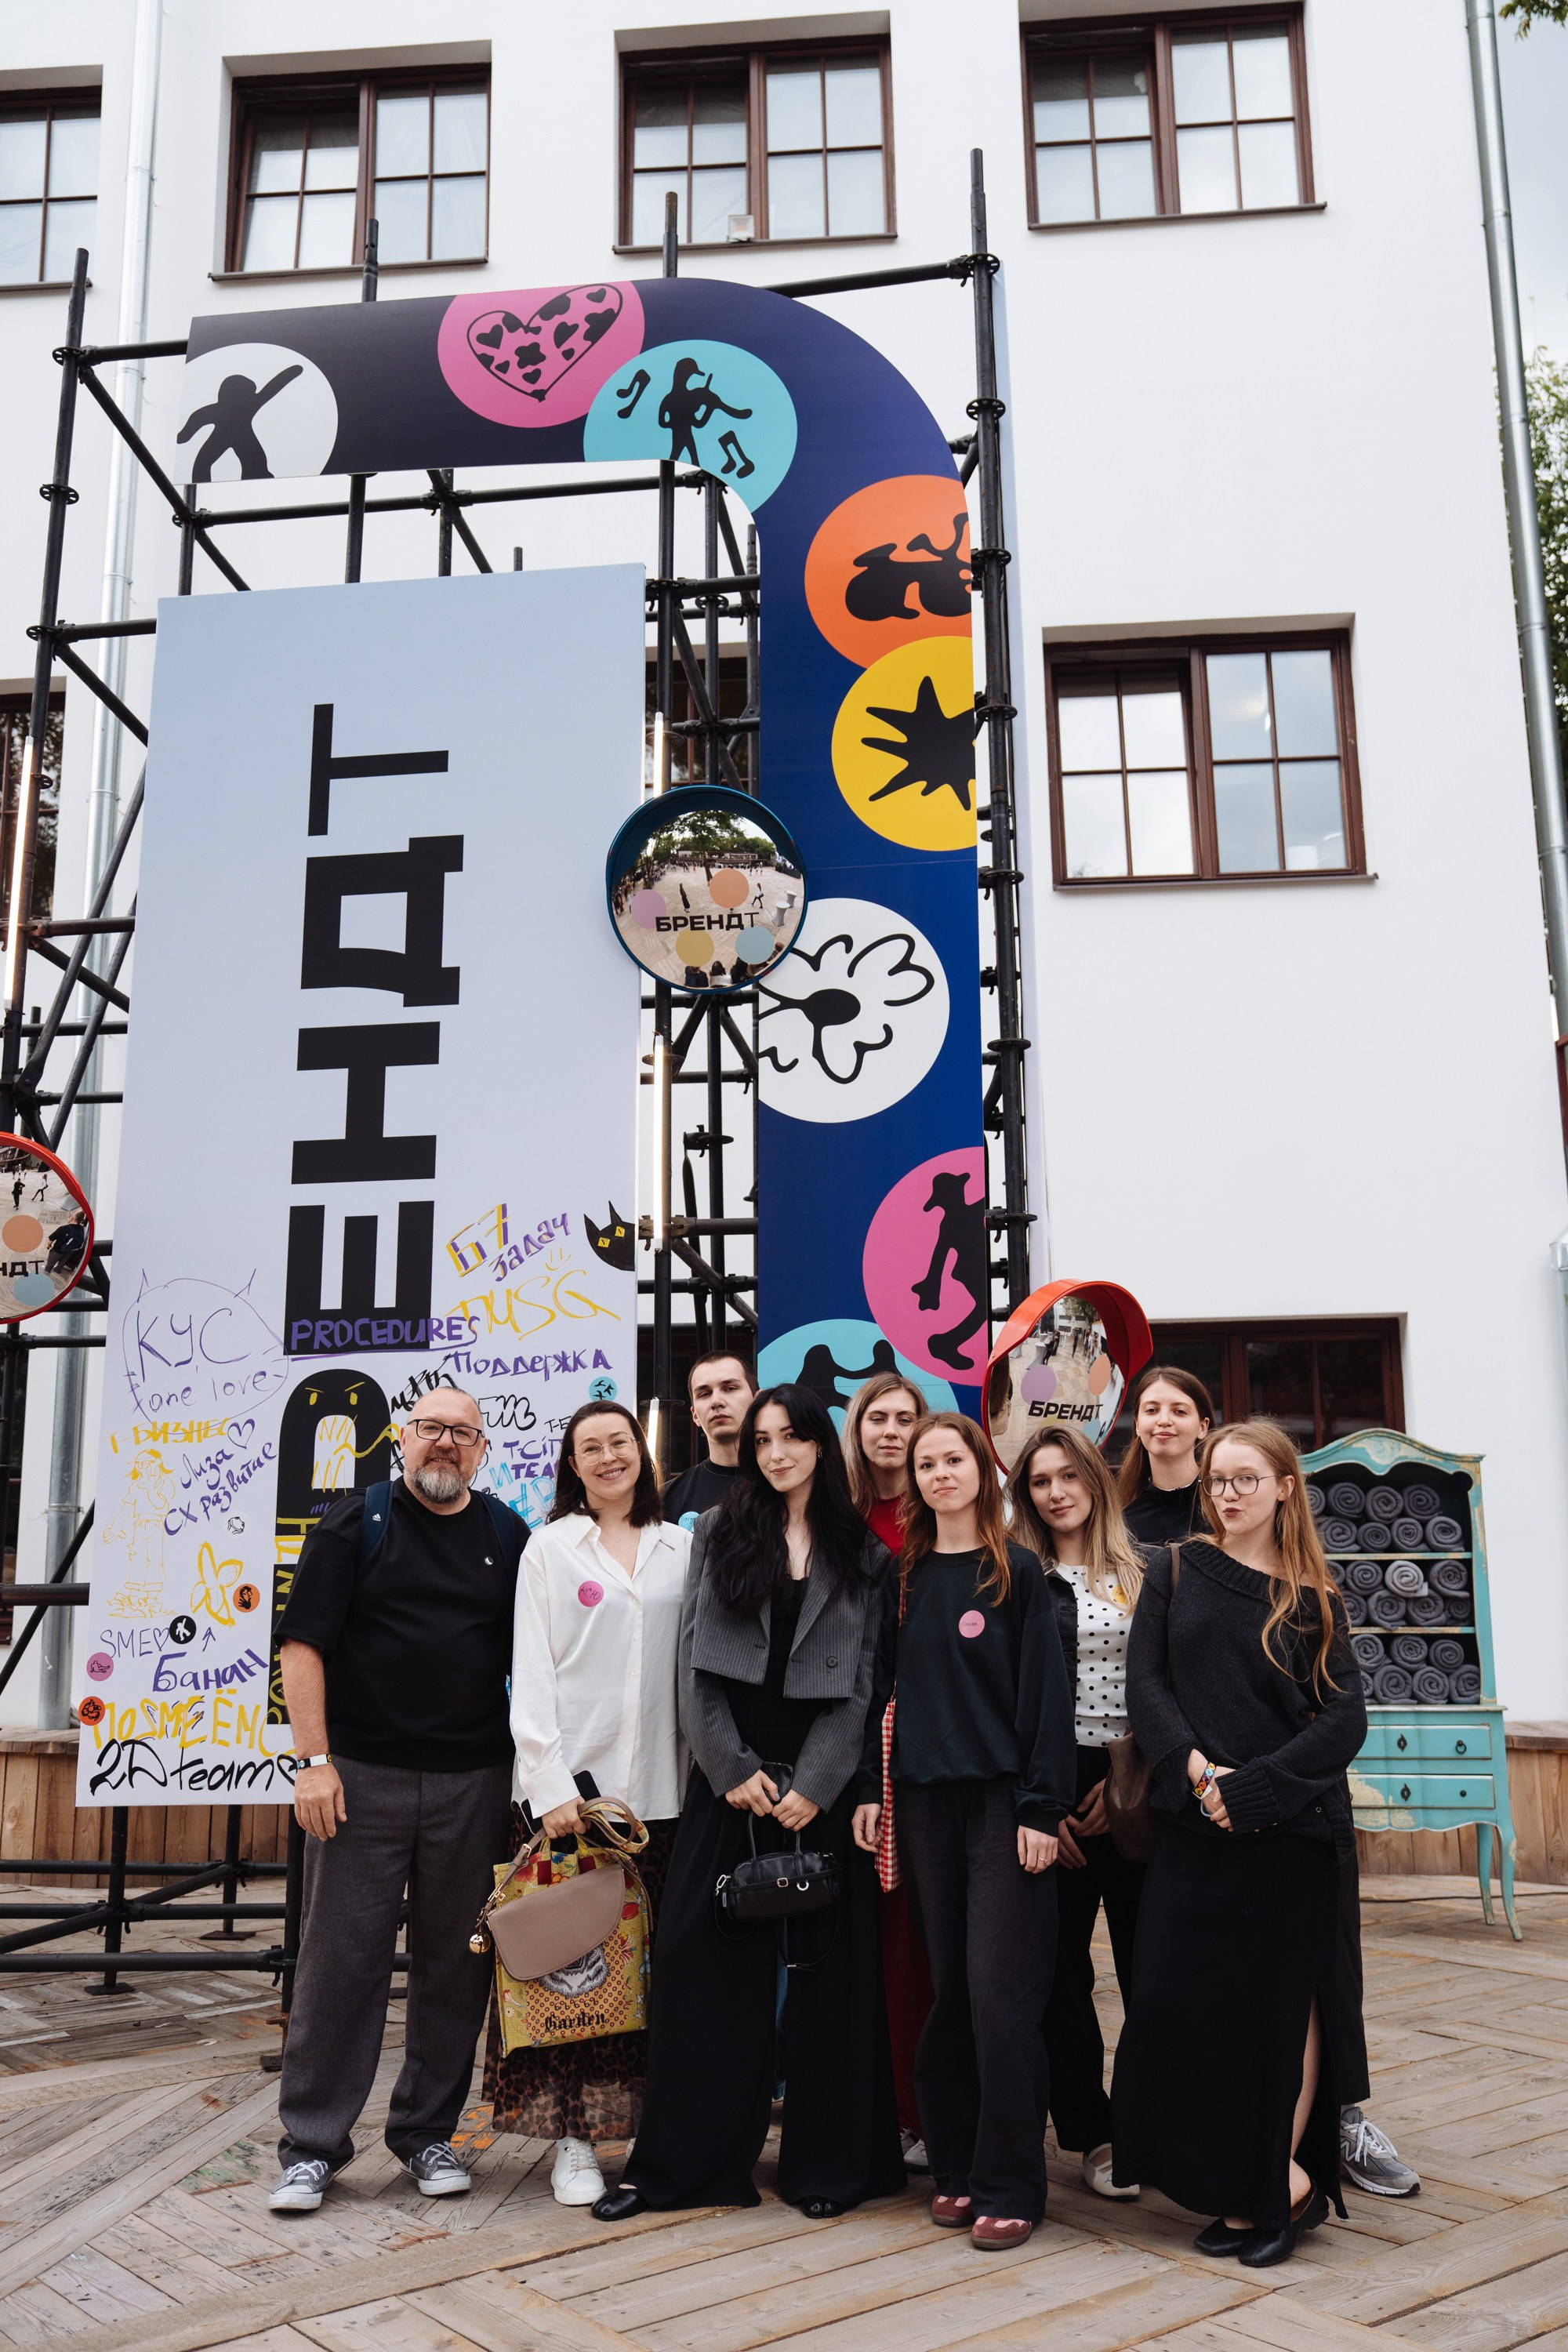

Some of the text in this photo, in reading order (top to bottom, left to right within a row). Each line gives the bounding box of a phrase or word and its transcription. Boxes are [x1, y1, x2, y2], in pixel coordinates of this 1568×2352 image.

[655, 913, 759, 931] БРЕНДТ
[267, 702, 464, 1725] РЕНДТ
[488, 1213, 571, 1281] задач
[136, 1308, 252, 1383] KYC
[291, 1315, 481, 1351] PROCEDURES
[149, 1370, 272, 1413] one love
[1028, 1400, 1103, 1421] БРЕНДТ
[180, 1449, 234, 1490] Лиза
[200, 1442, 277, 1522] развитие
[511, 1459, 560, 1480] TEA
[100, 1628, 153, 1658] SME
[153, 1649, 268, 1692] Банан
[89, 1738, 168, 1796] 2D
[545, 2012, 607, 2033] Garden
